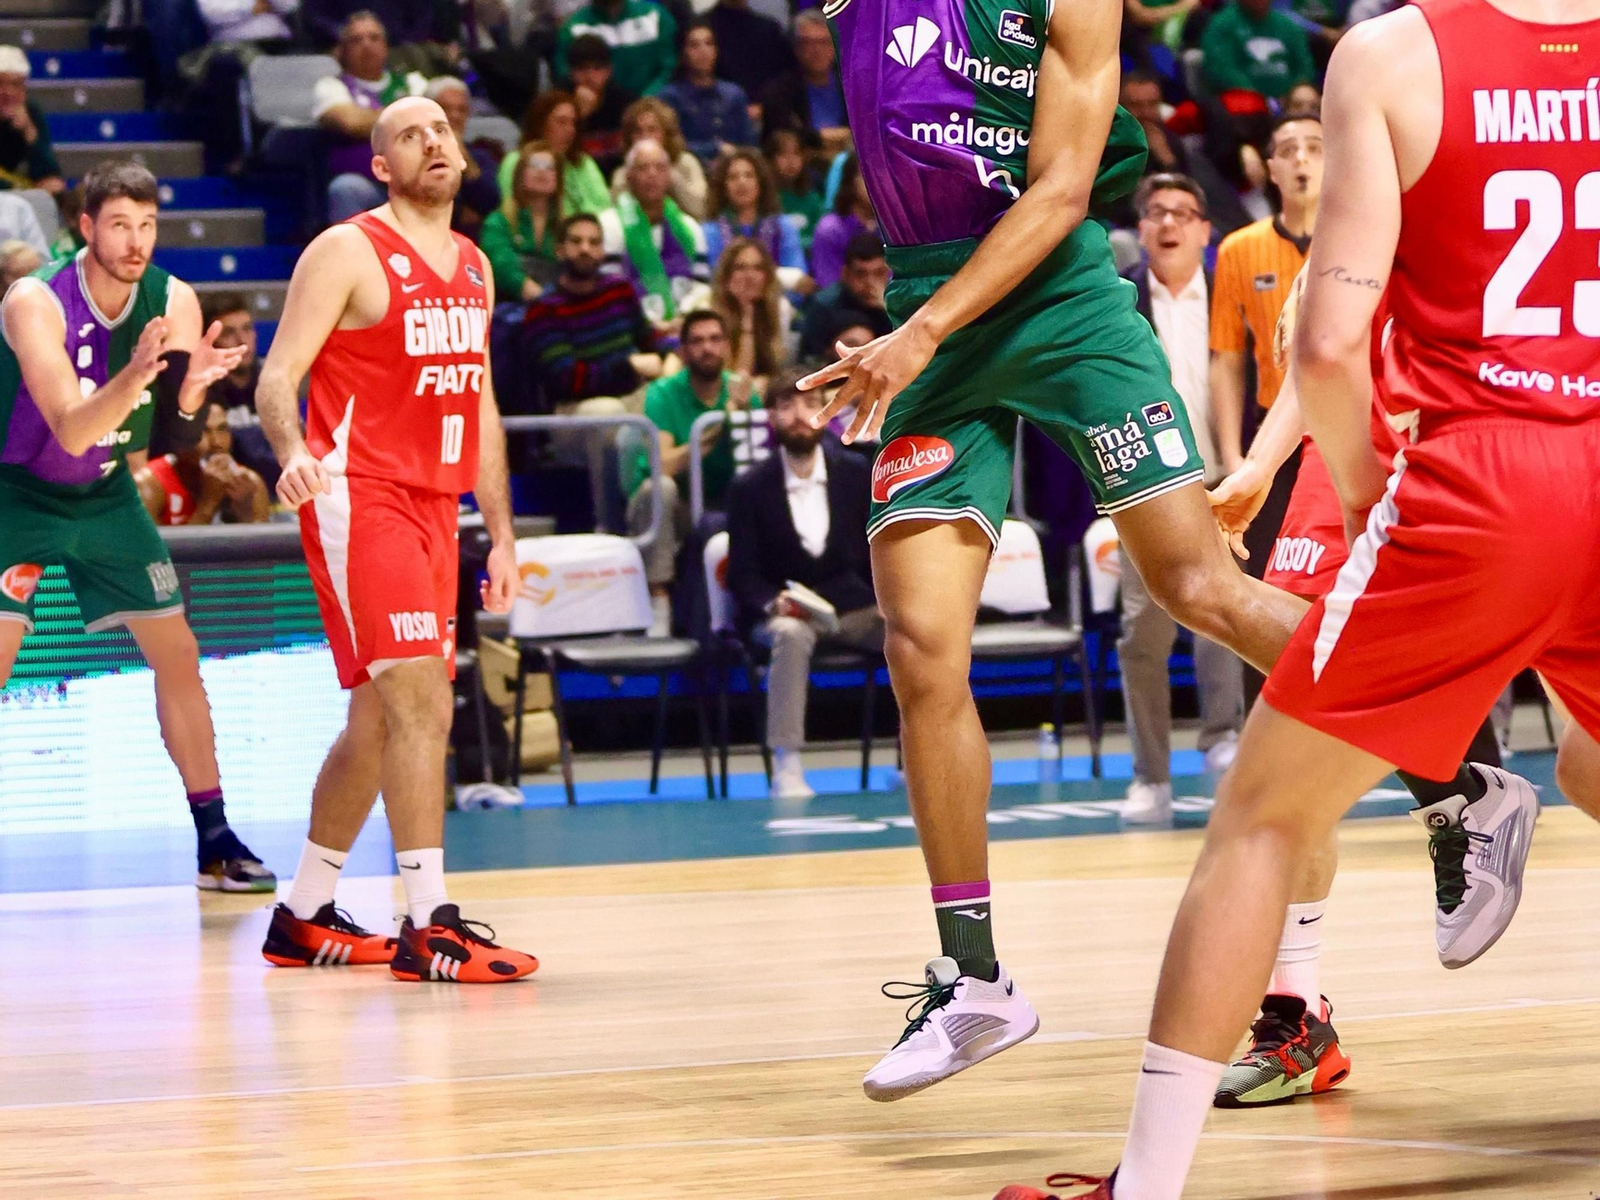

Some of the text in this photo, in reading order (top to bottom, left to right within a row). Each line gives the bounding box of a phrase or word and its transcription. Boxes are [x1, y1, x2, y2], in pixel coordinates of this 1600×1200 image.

[1003, 28, 1035, 44] endesa
[944, 41, 1038, 97] Unicaj
[1473, 77, 1600, 143] MARTÍ
[1479, 362, 1555, 393] Kave
[1149, 411, 1167, 423] acb
[441, 414, 464, 464] 10
[1094, 440, 1152, 472] laga
